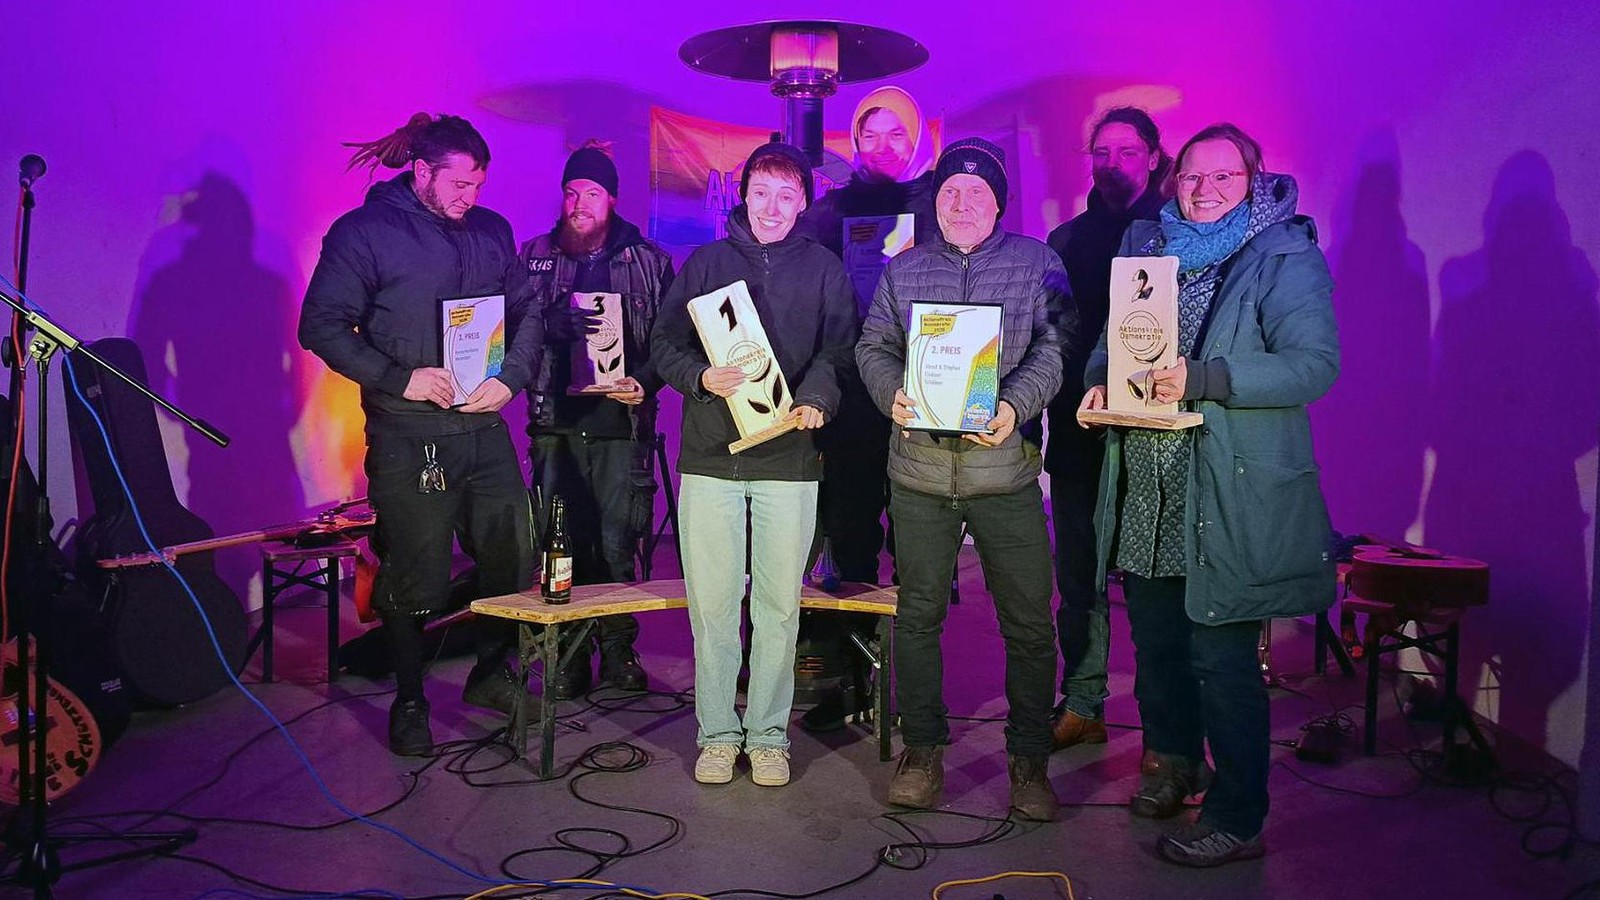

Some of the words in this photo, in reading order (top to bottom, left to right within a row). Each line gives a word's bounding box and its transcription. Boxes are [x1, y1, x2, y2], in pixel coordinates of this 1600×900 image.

[1131, 268, 1154, 303] 2
[593, 296, 606, 317] 3
[719, 295, 738, 332] 1
[931, 345, 939, 355] 2.
[940, 346, 961, 355] PREIS
